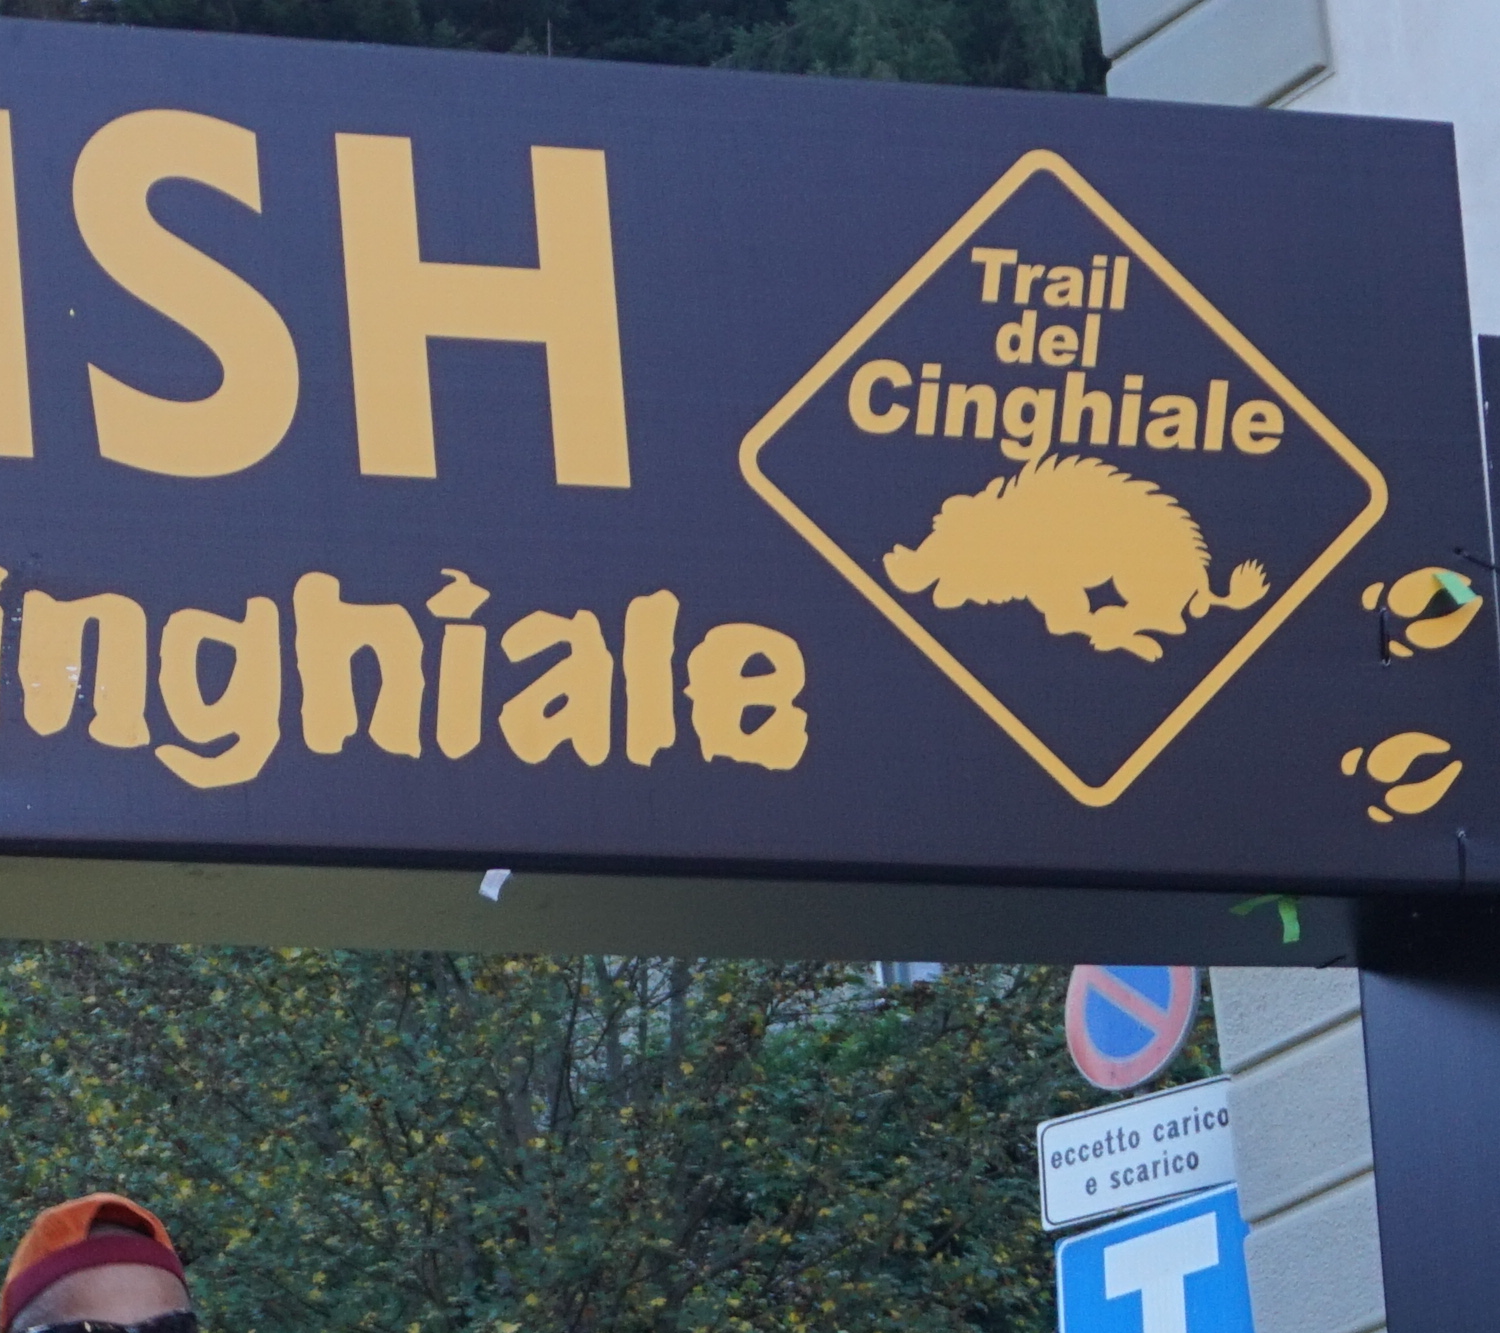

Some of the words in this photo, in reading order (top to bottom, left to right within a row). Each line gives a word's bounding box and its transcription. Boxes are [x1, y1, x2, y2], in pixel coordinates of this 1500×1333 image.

[971, 246, 1129, 312] Trail
[995, 311, 1101, 368] del
[847, 357, 1285, 461] Cinghiale
[1050, 1125, 1141, 1170] eccetto
[1152, 1102, 1230, 1143] carico
[1085, 1174, 1098, 1197] e
[1109, 1148, 1200, 1192] scarico
